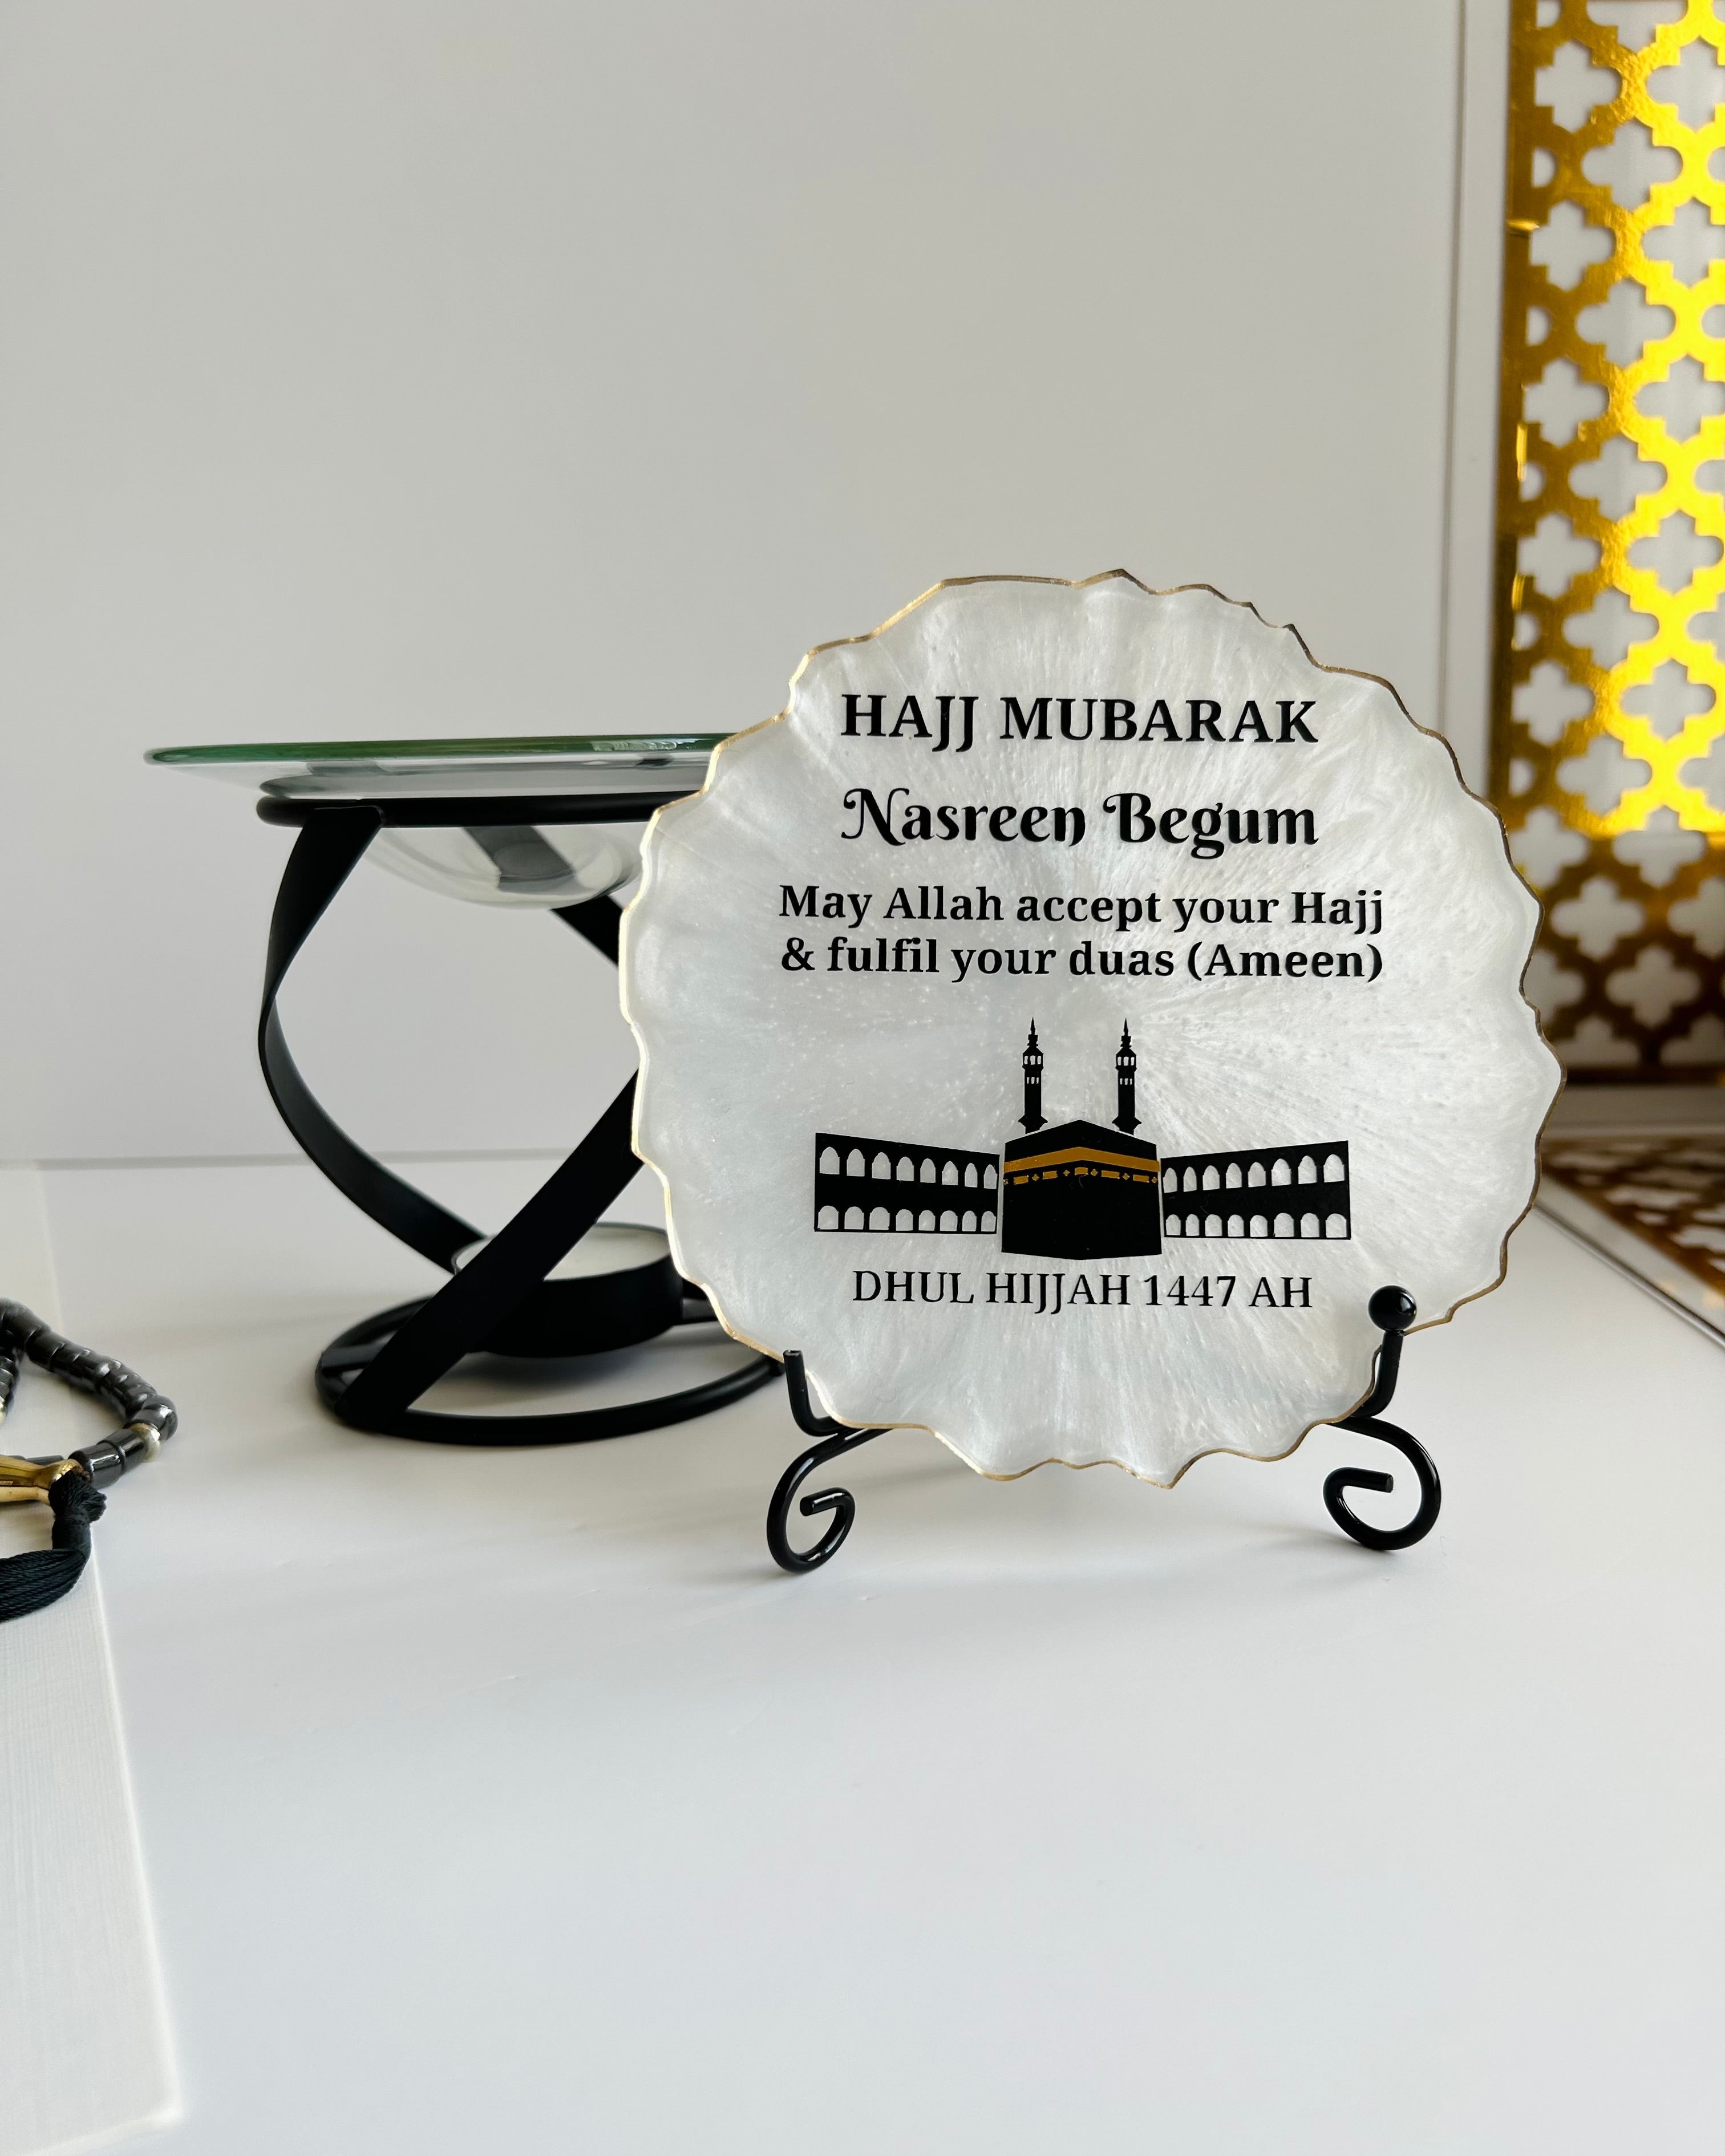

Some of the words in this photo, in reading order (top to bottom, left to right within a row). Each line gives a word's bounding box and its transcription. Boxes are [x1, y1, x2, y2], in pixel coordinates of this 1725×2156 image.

[840, 694, 979, 753] HAJJ
[999, 696, 1319, 743] MUBARAK
[841, 787, 1086, 847] Nasreen
[1102, 792, 1319, 860] Begum
[779, 885, 873, 929] May
[882, 885, 1005, 921] Allah
[1017, 893, 1162, 932] accept
[1172, 898, 1279, 934] your
[1291, 889, 1382, 935] Hajj
[781, 937, 815, 972] &
[827, 936, 940, 973] fulfil
[950, 949, 1056, 983] your
[1069, 941, 1174, 976] duas
[1187, 941, 1383, 983] (Ameen)
[852, 1270, 975, 1304] DHUL
[986, 1272, 1131, 1315] HIJJAH
[1144, 1275, 1236, 1307] 1447
[1248, 1276, 1313, 1308] AH
